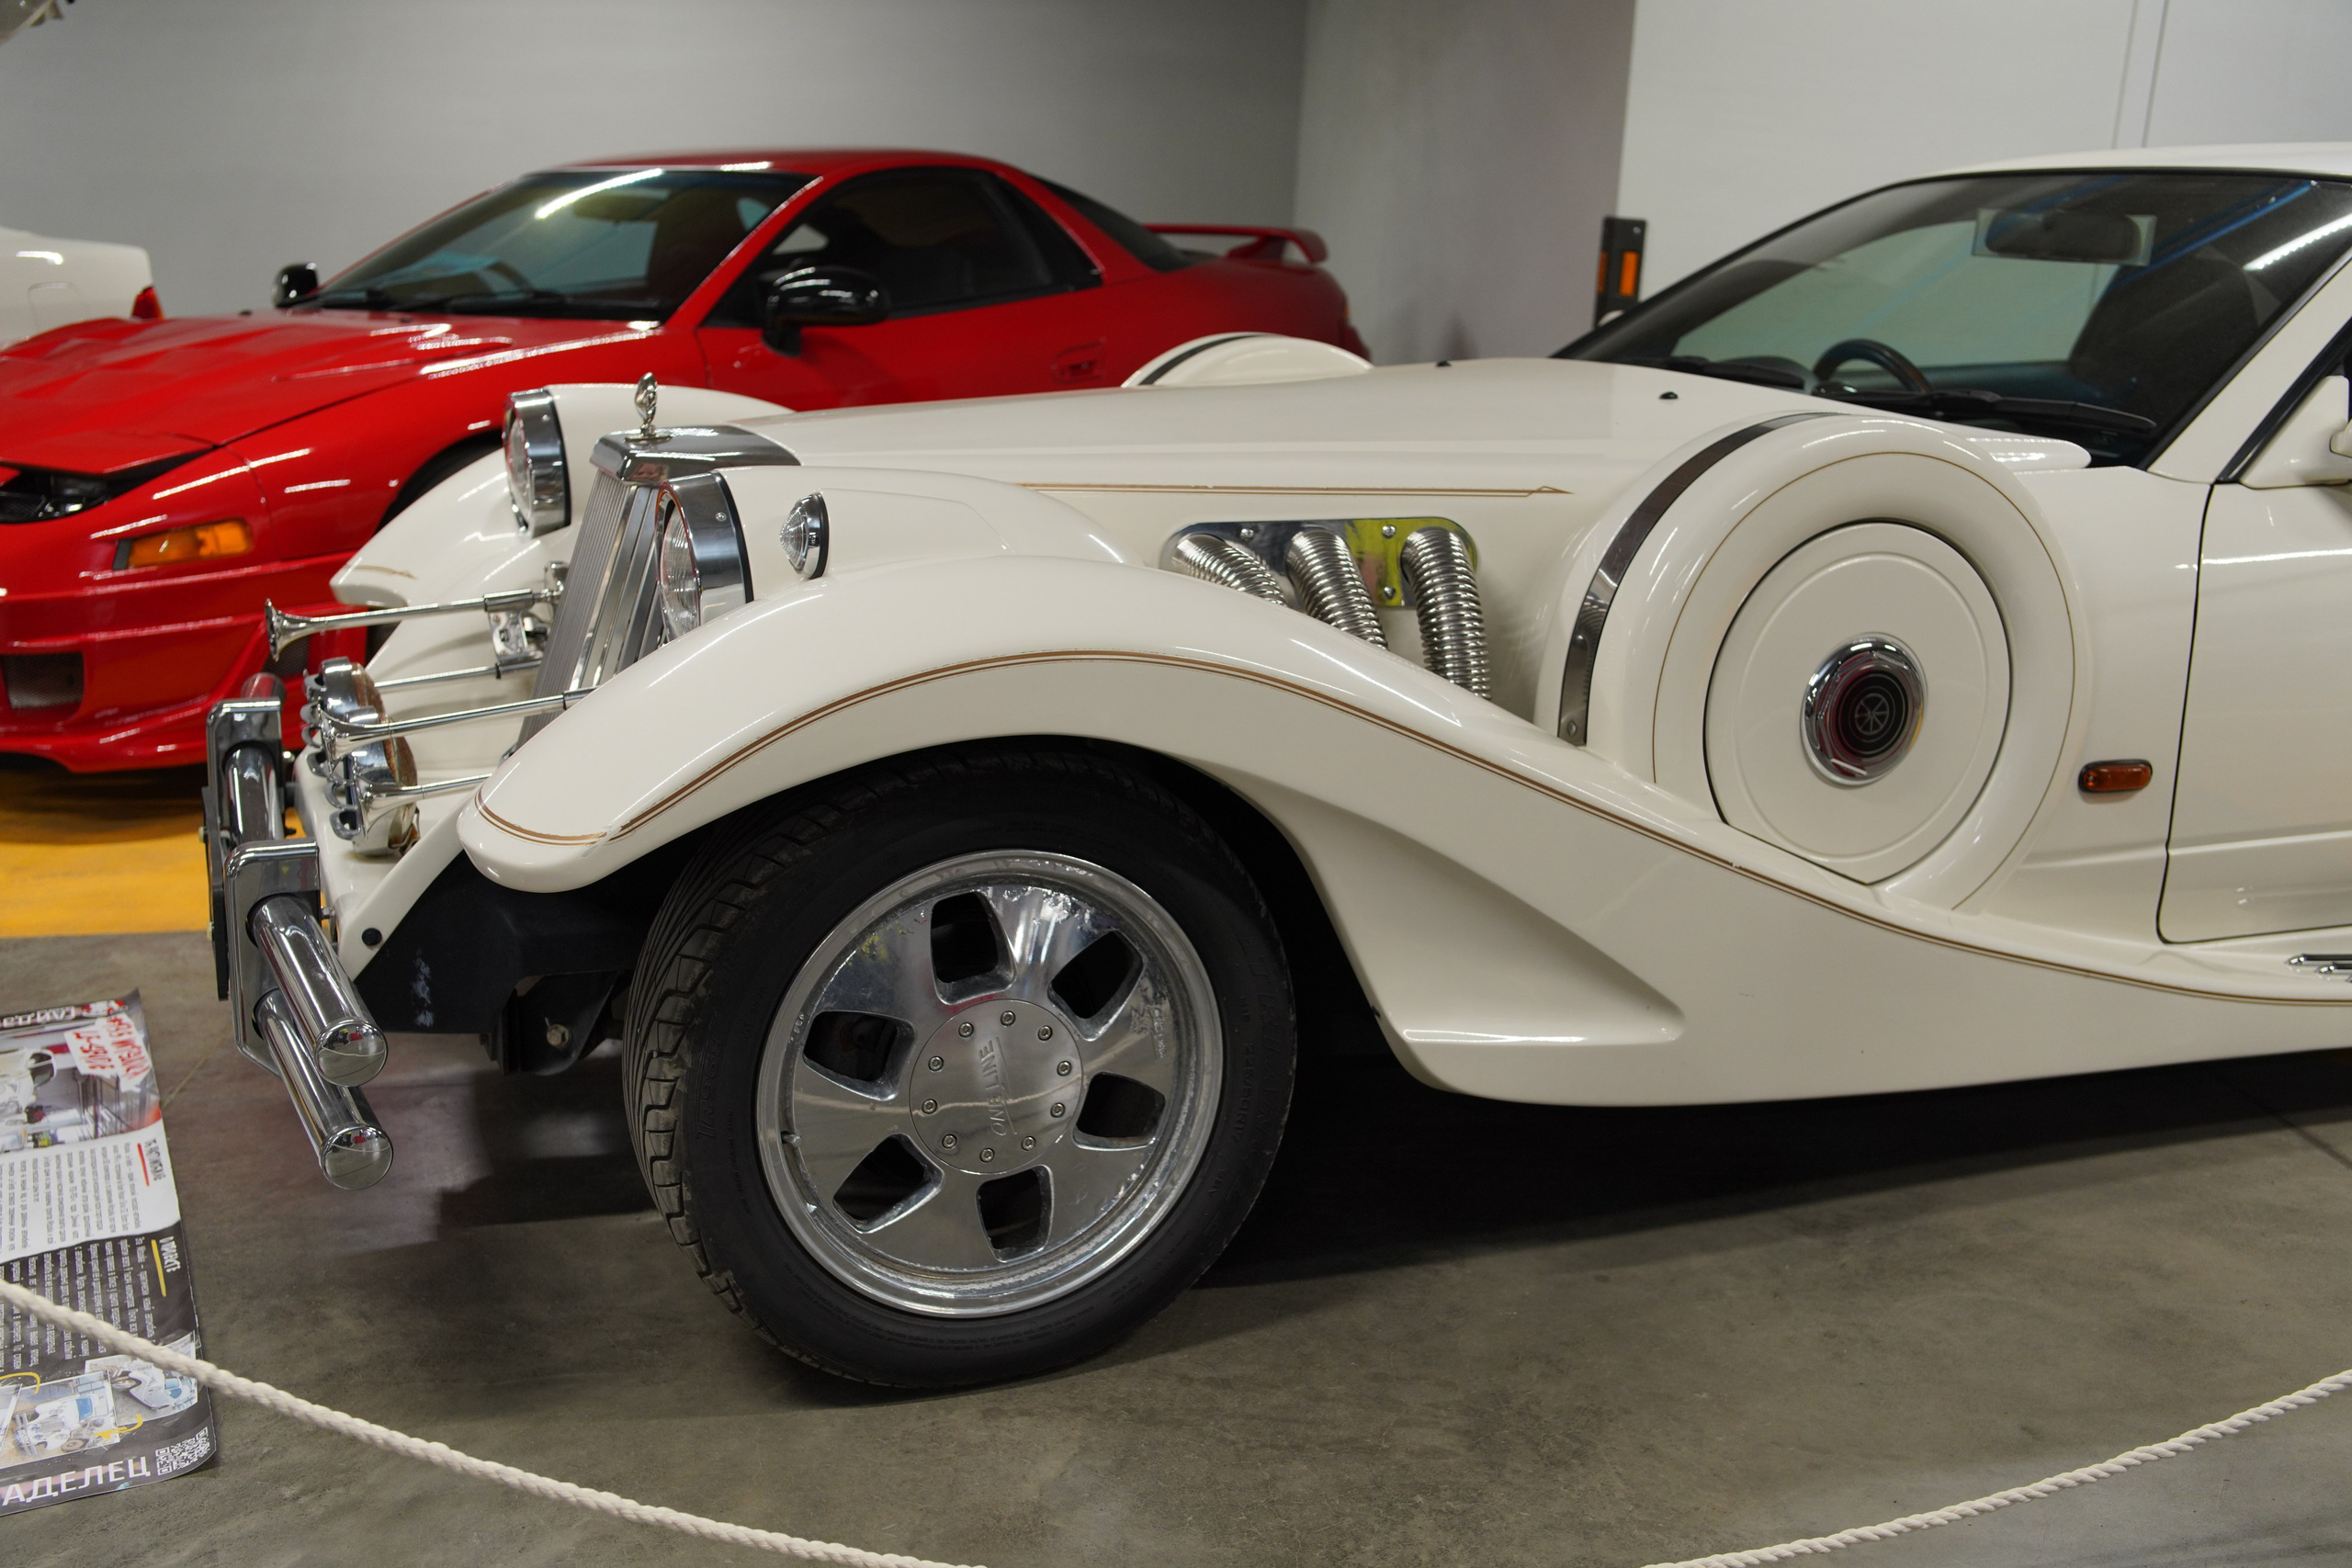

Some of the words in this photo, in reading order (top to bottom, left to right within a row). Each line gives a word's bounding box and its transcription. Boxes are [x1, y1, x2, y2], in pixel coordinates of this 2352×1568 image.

[979, 1039, 1001, 1091] LINE
[987, 1095, 1007, 1136] ONE
[2, 1456, 151, 1506] АДЕЛЕЦ
